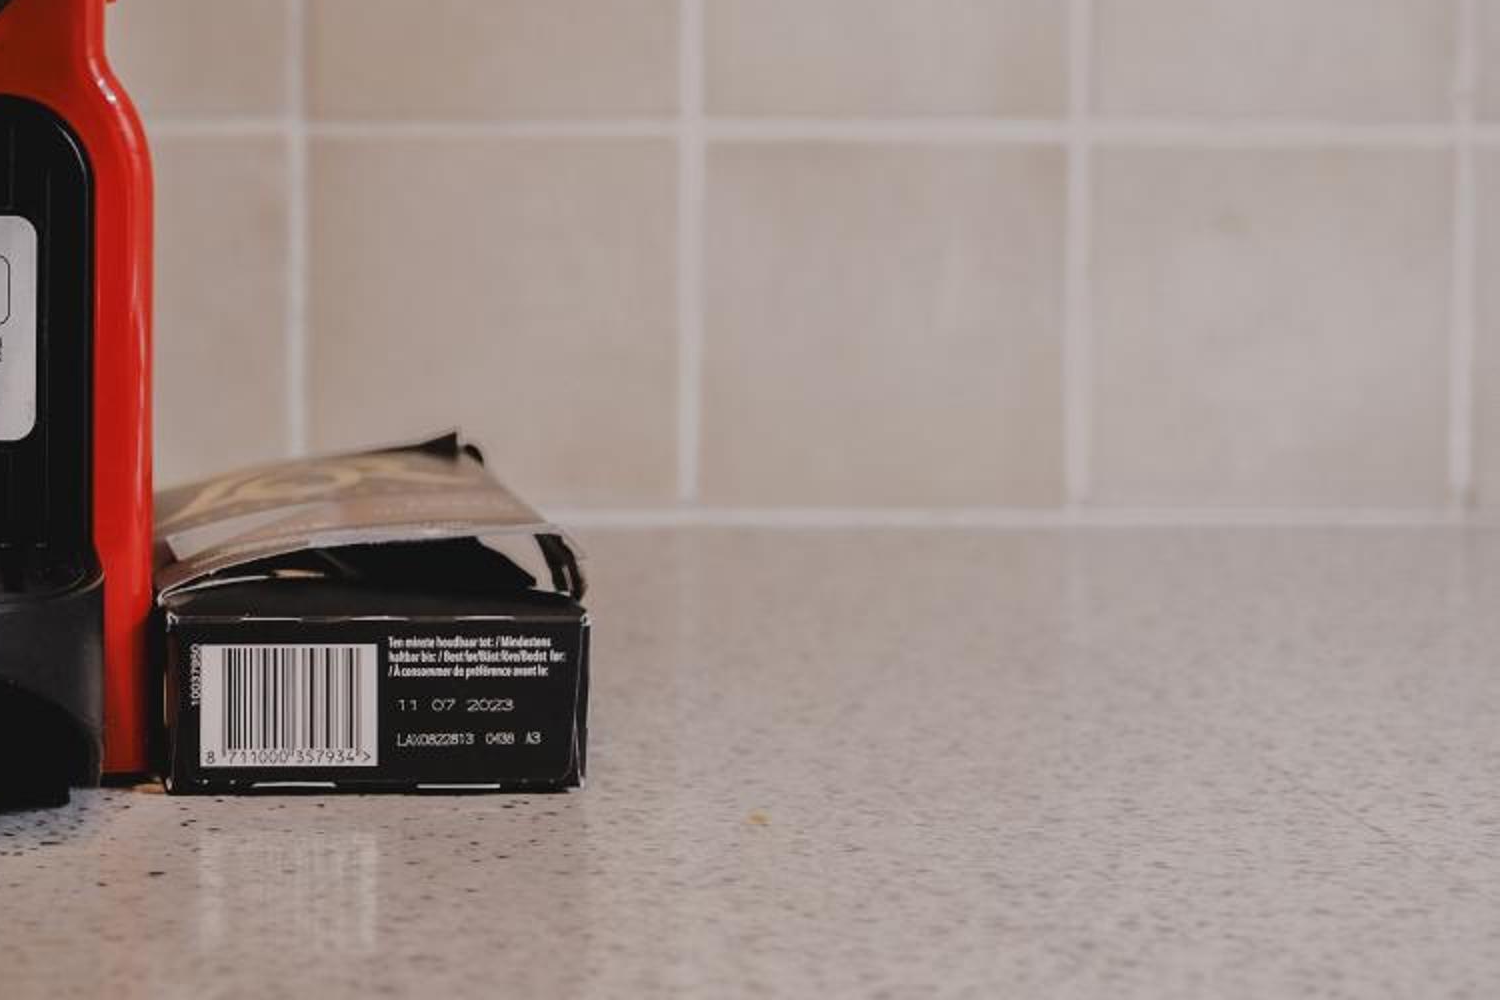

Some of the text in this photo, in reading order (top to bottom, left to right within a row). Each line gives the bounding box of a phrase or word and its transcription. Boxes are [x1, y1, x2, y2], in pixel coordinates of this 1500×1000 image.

[431, 698, 456, 711] 07
[467, 698, 514, 712] 2023
[206, 750, 216, 764] 8
